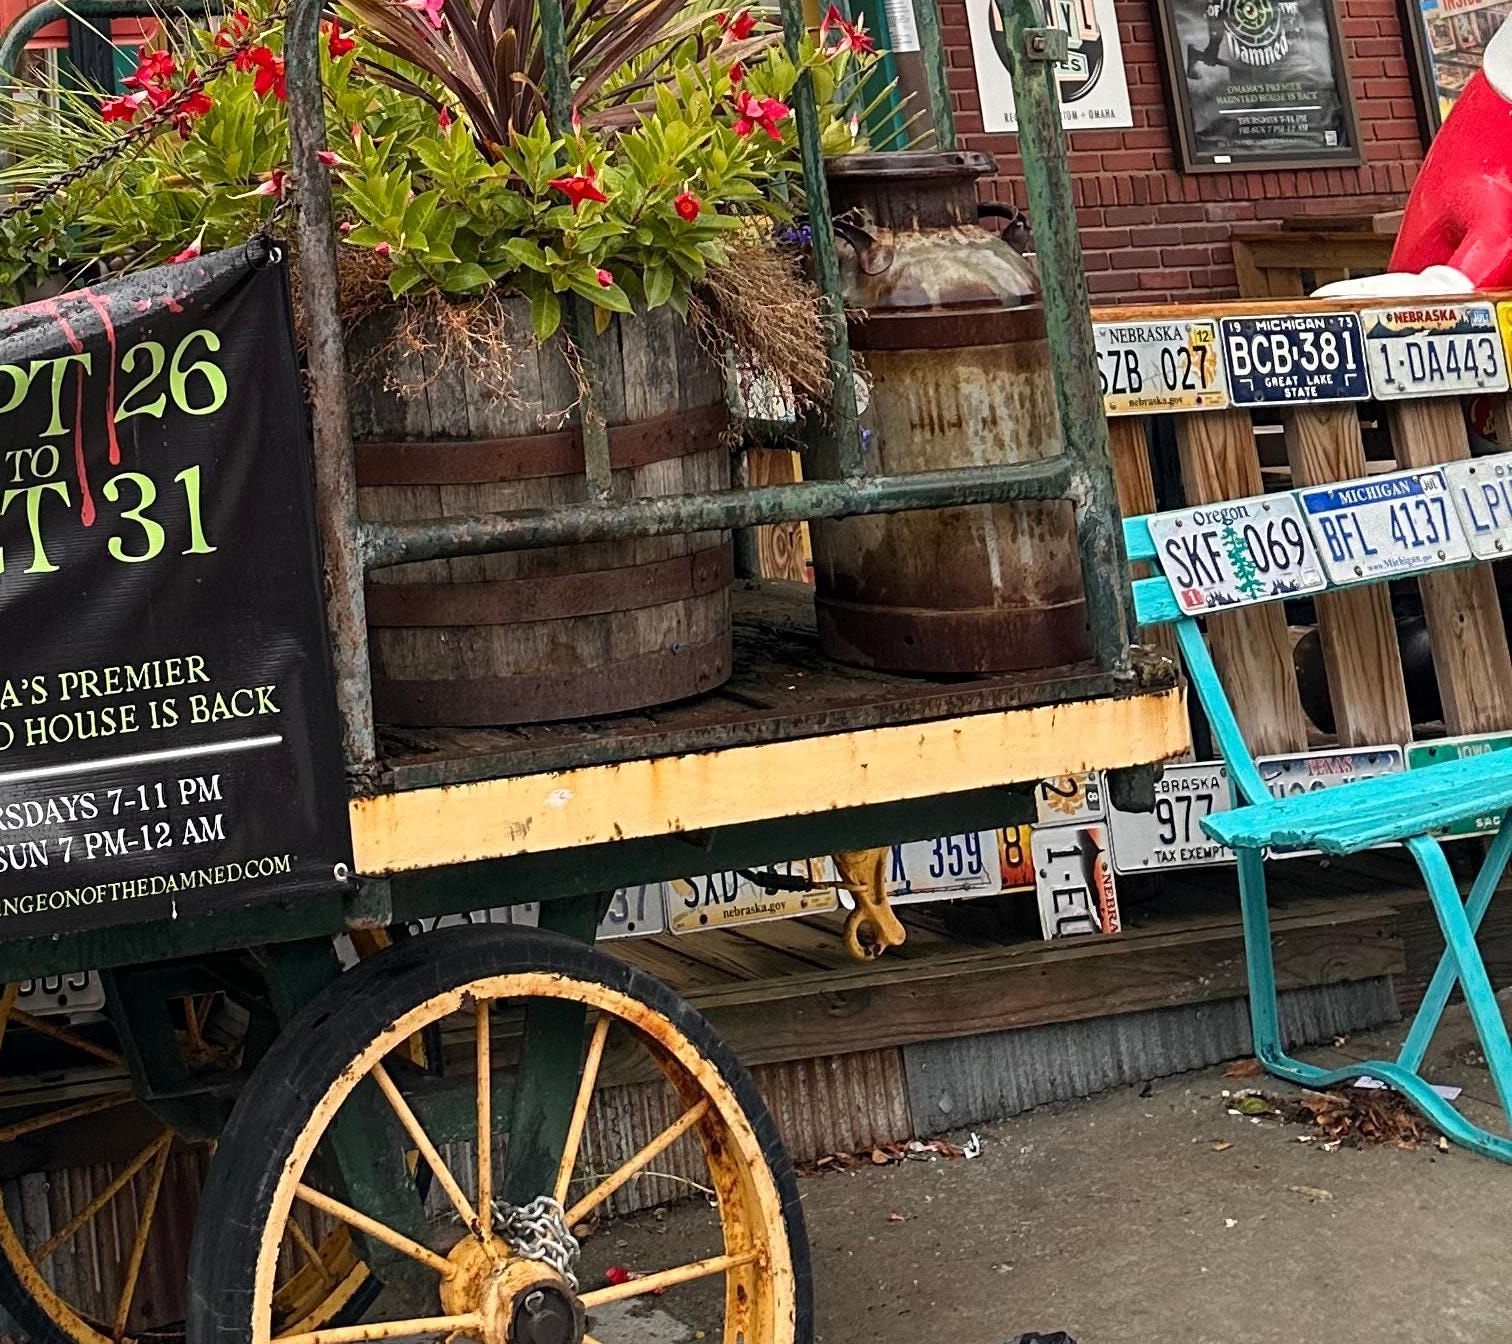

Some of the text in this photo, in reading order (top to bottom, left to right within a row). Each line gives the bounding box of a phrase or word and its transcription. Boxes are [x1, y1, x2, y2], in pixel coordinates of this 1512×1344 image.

[1207, 1, 1299, 18] OF THE
[1225, 28, 1289, 67] Damned
[1229, 317, 1354, 333] 19 MICHIGAN 73
[1393, 309, 1457, 324] NEBRASKA
[1109, 326, 1183, 345] NEBRASKA
[1196, 330, 1209, 343] 12
[113, 328, 229, 424] 26
[1161, 345, 1207, 391] 027
[1265, 374, 1334, 388] GREAT LAKE
[1284, 386, 1318, 398] STATE
[5, 444, 60, 483] TO
[1338, 479, 1411, 505] MICHIGAN
[102, 464, 218, 564] 31
[1192, 503, 1250, 527] Oregon
[1319, 496, 1451, 562] BFL 4137
[1165, 516, 1306, 588] SKF 069
[58, 654, 211, 699] PREMIER
[25, 705, 140, 747] HOUSE
[148, 698, 179, 730] IS
[190, 684, 282, 725] BACK
[1307, 755, 1353, 777] TEXAS
[106, 781, 170, 816] 7-11
[178, 773, 224, 807] PM
[58, 835, 74, 863] 7
[84, 820, 174, 861] PM-12
[182, 813, 228, 846] AM
[1154, 845, 1227, 863] TAX EXEMPT
[722, 901, 786, 919] nebraska.gov
